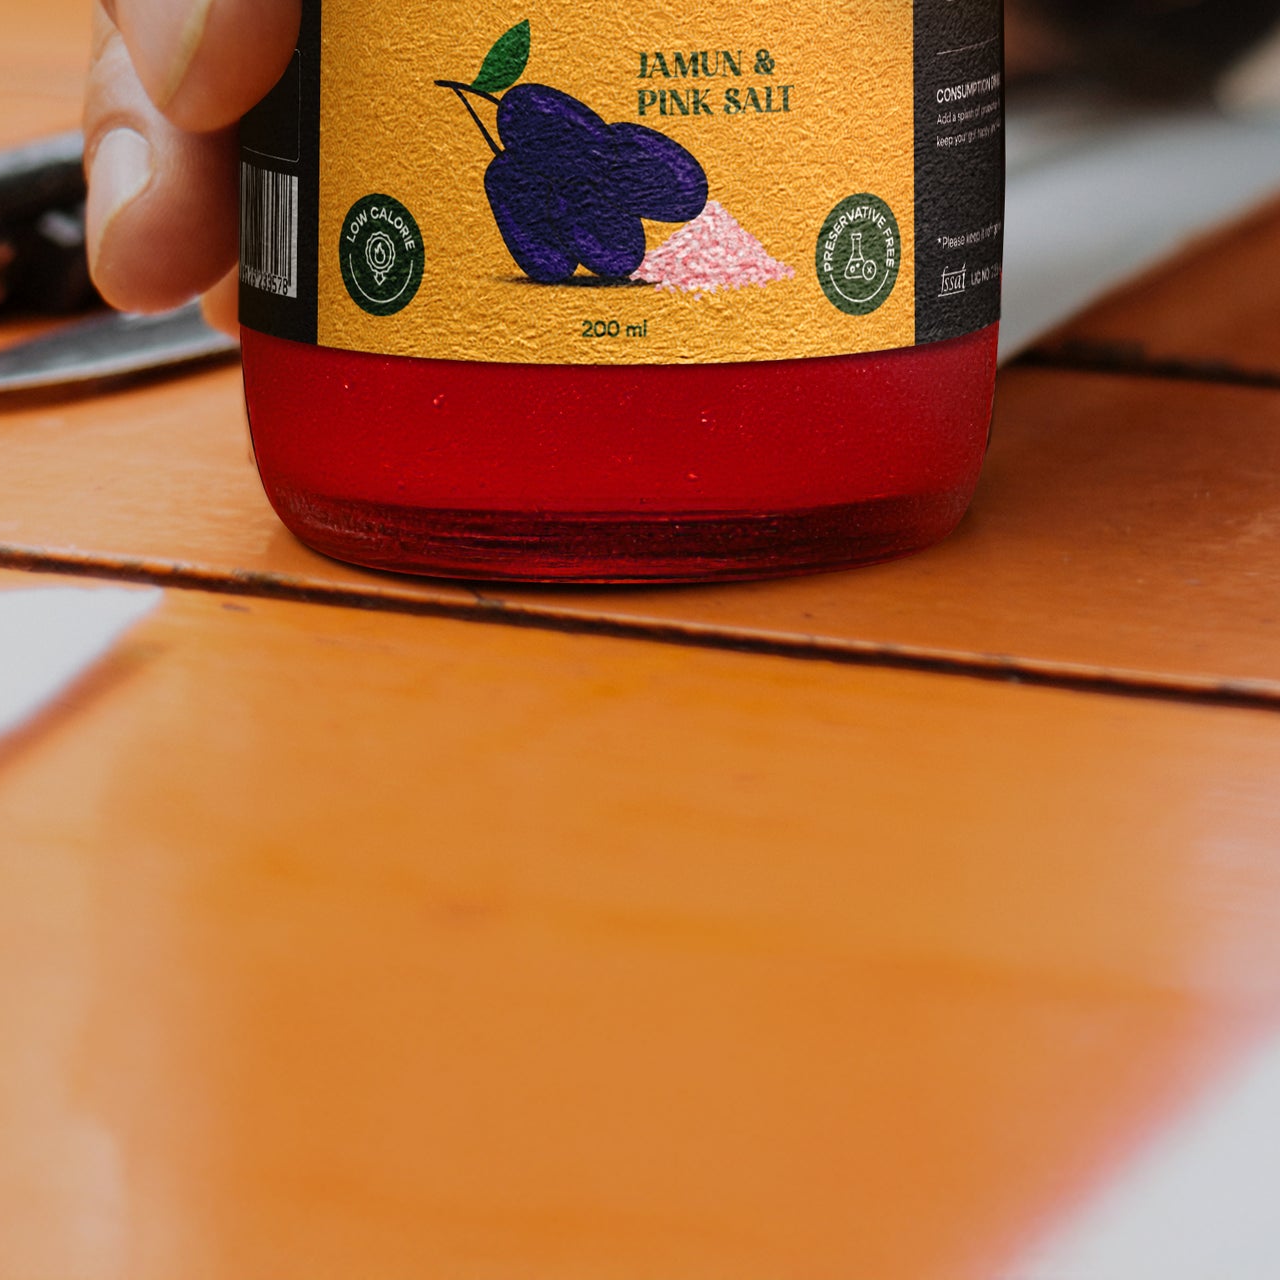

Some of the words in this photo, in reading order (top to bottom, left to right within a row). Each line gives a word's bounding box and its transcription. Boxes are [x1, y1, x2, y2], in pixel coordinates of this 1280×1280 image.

[636, 50, 742, 78] JAMUN
[754, 48, 775, 75] &
[637, 89, 714, 116] PINK
[723, 85, 794, 114] SALT
[936, 76, 991, 103] CONSUMPTION
[936, 111, 951, 125] Add
[952, 113, 957, 122] a
[936, 135, 953, 147] keep
[346, 209, 368, 243] LOW
[370, 206, 415, 251] CALORIE
[823, 206, 886, 272] PRESERVATIVE
[882, 227, 895, 268] FREE
[582, 320, 620, 338] 200
[626, 319, 647, 337] ml
